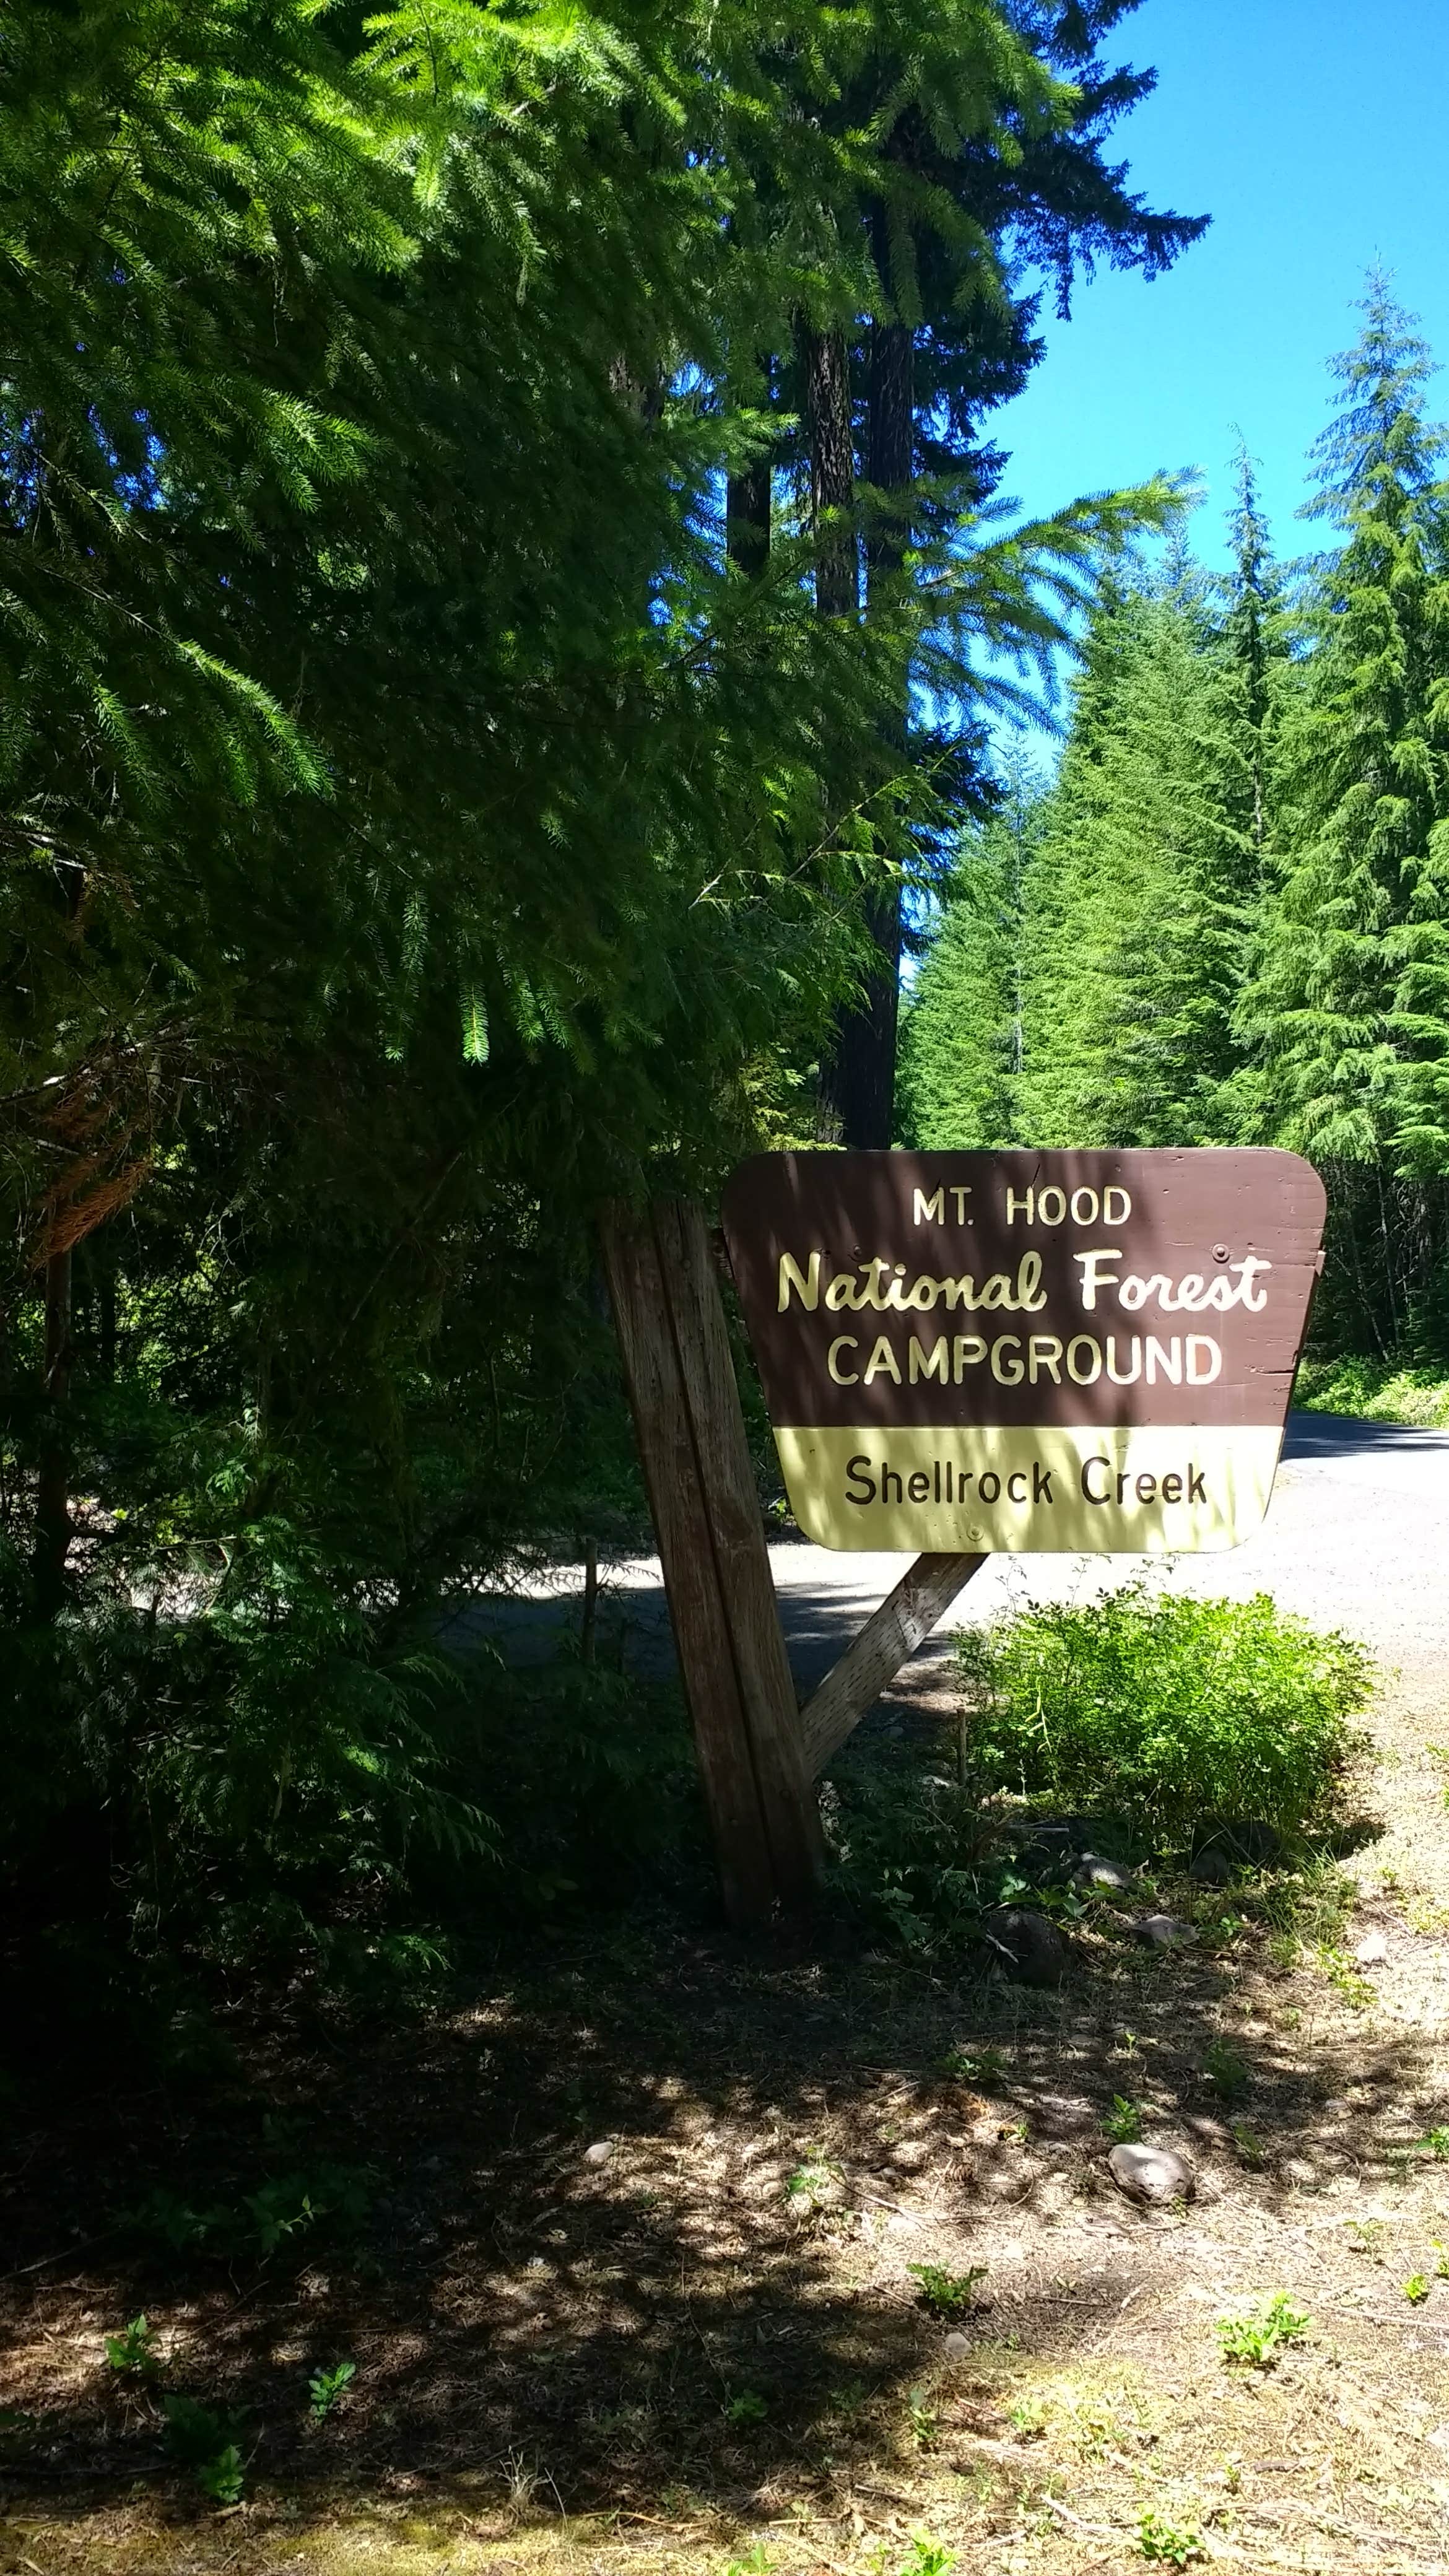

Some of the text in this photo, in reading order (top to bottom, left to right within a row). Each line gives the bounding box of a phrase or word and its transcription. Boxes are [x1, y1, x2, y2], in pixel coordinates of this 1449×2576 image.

[913, 1185, 1132, 1226] MT. HOOD
[777, 1248, 1273, 1313] National Forest
[827, 1333, 1222, 1386] CAMPGROUND
[845, 1455, 1208, 1505] Shellrock Creek
